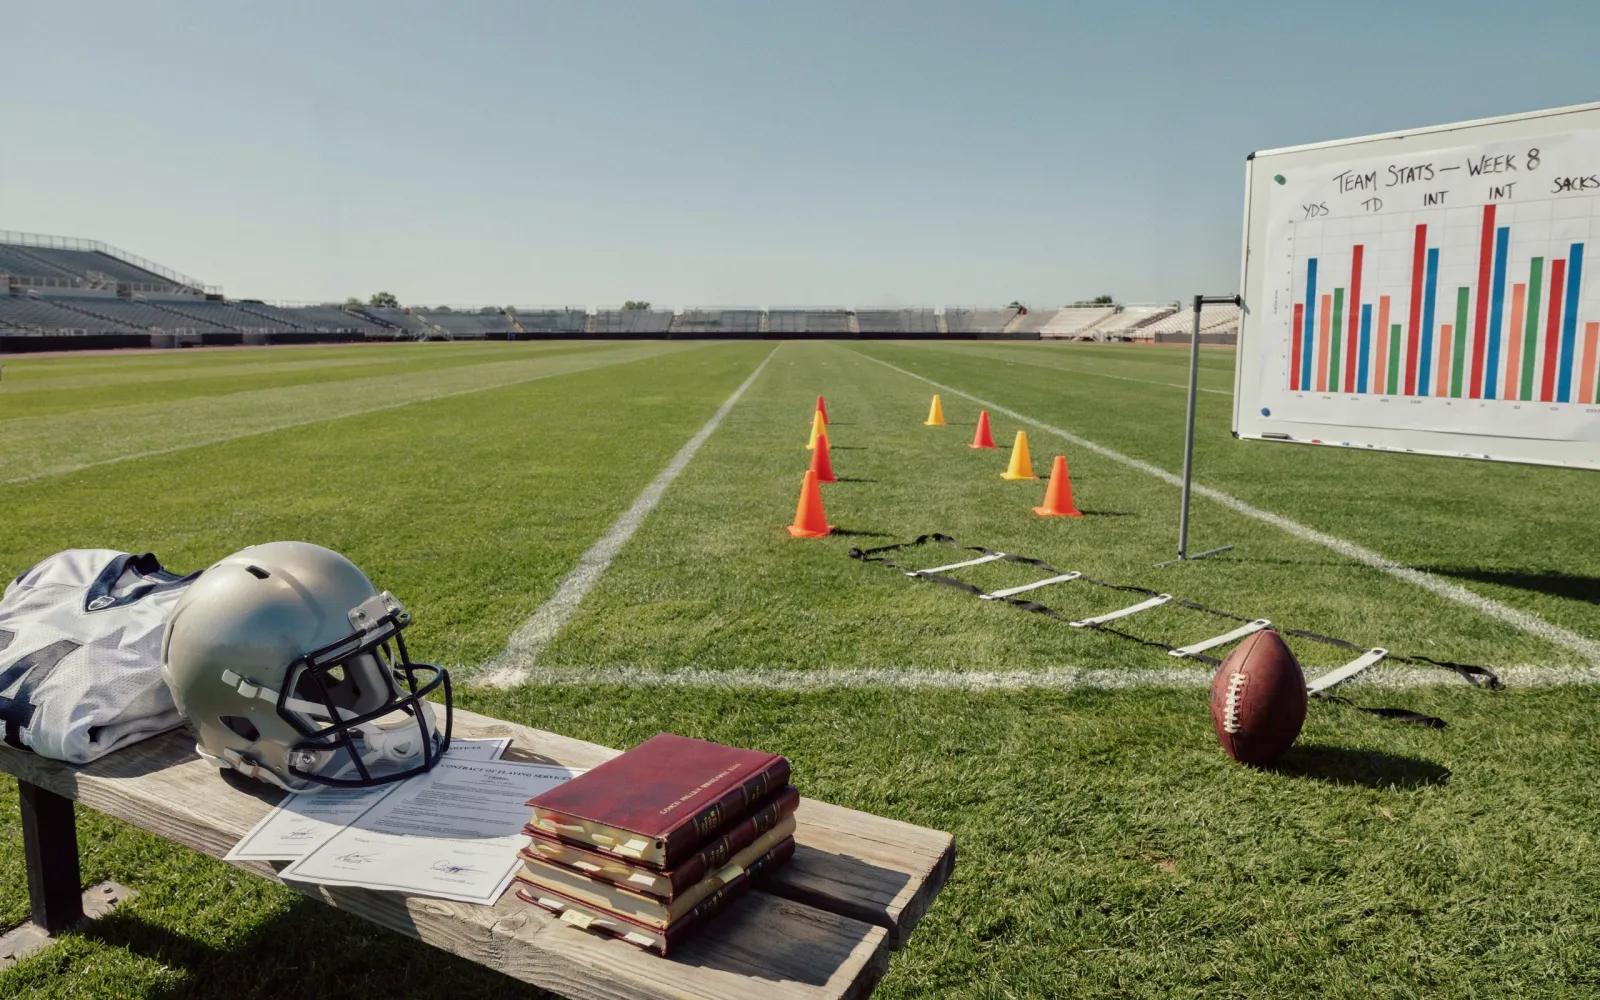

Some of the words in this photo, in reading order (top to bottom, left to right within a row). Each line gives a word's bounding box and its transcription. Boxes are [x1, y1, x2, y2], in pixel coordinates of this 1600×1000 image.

[1332, 170, 1377, 194] TEAM
[1385, 163, 1434, 187] STATS
[1467, 154, 1517, 177] WEEK
[1526, 147, 1541, 171] 8
[1302, 202, 1329, 220] YDS
[1361, 197, 1383, 212] TD
[1423, 190, 1449, 206] INT
[1489, 182, 1517, 200] INT
[1550, 174, 1600, 193] SACKS
[441, 764, 482, 772] CONTRACT
